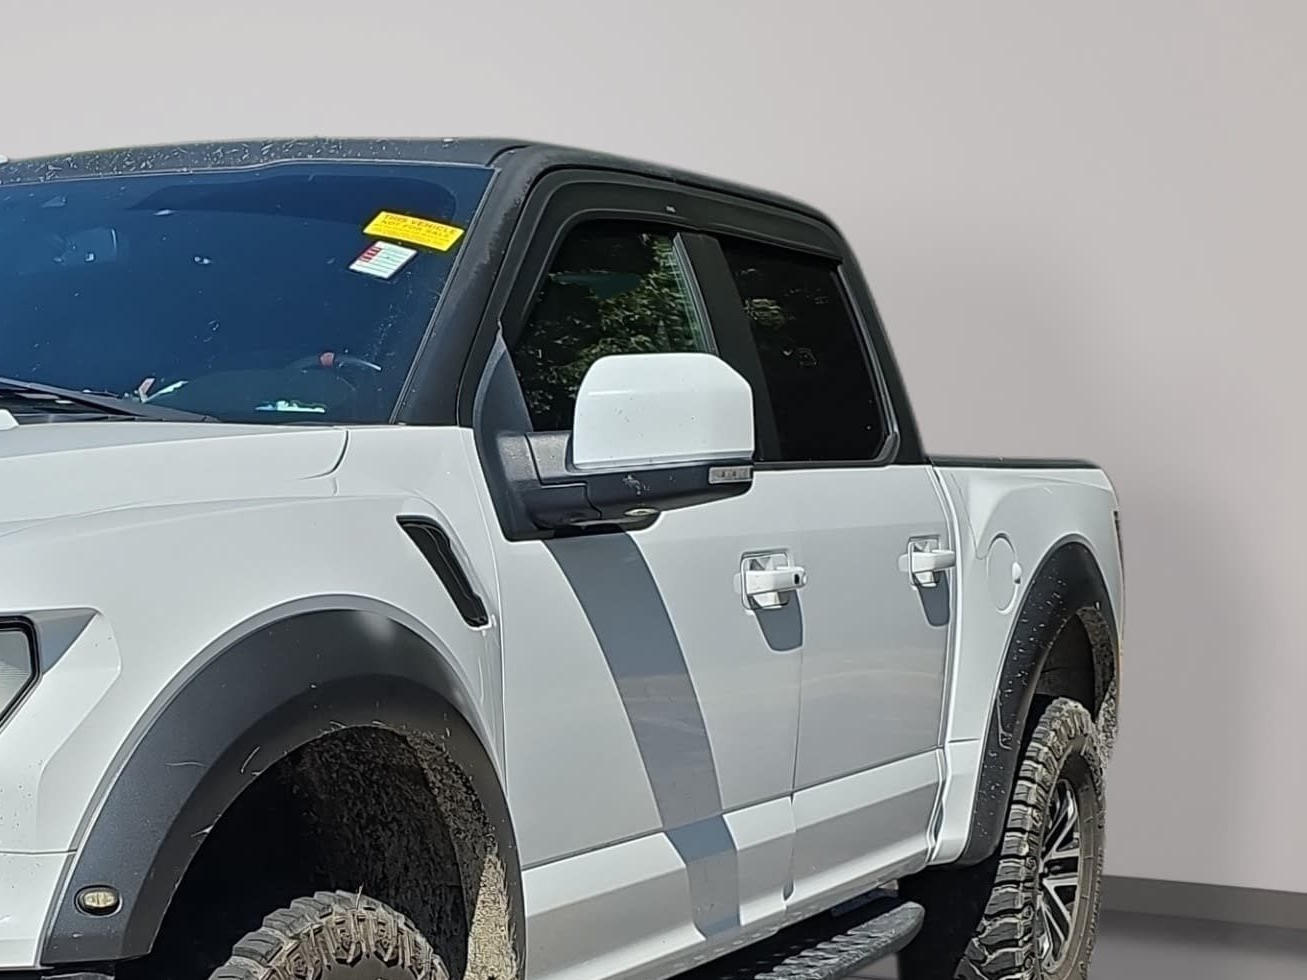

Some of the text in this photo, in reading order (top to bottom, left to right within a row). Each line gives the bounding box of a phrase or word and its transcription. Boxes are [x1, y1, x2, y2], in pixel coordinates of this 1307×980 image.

[381, 219, 450, 238] NOT FOR SALE
[385, 214, 458, 235] THIS VEHICLE
